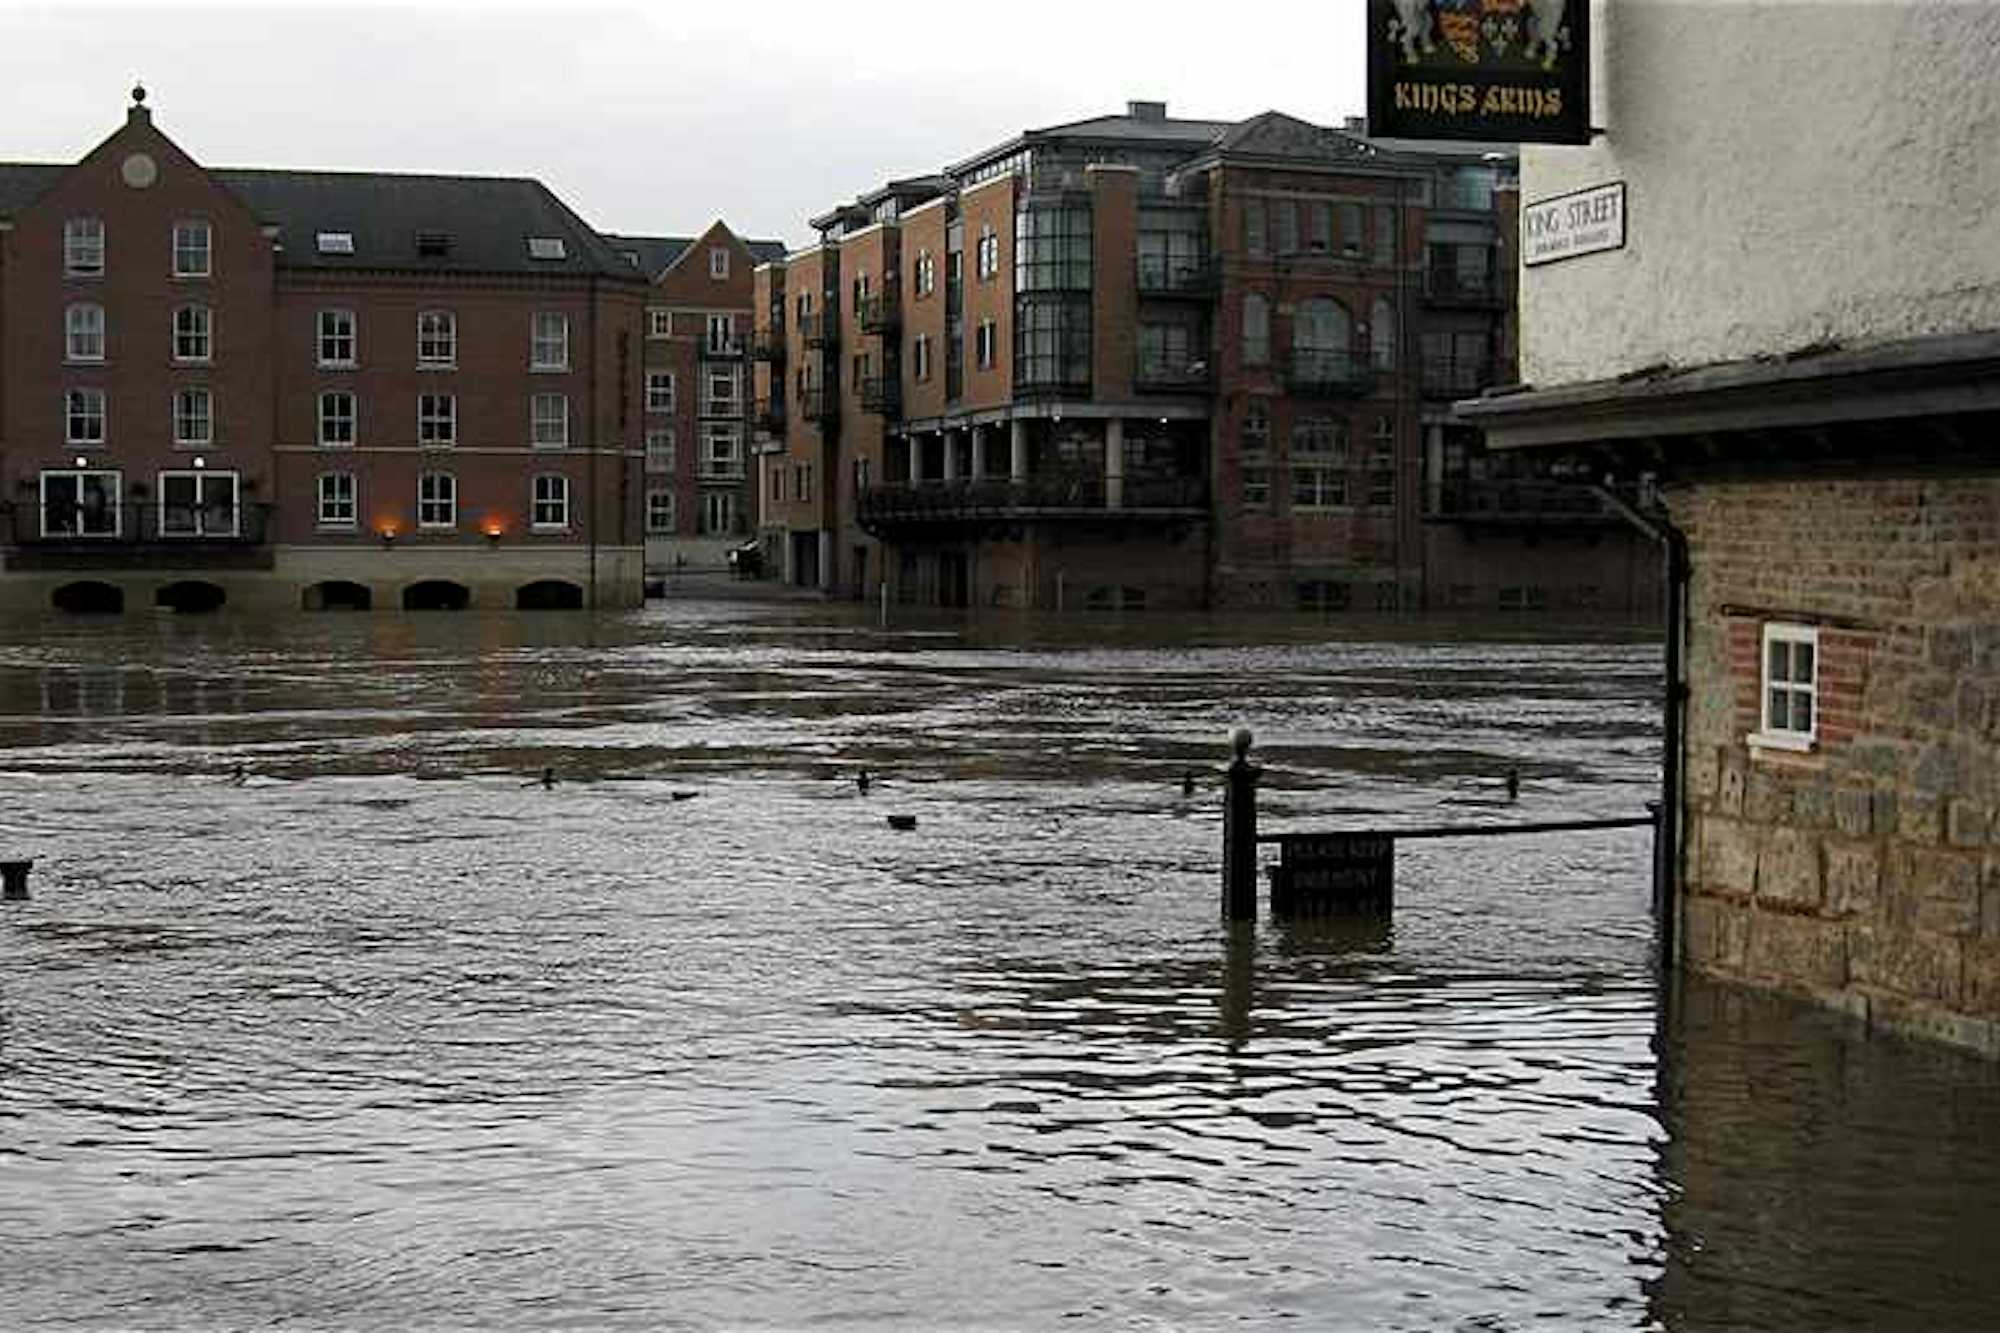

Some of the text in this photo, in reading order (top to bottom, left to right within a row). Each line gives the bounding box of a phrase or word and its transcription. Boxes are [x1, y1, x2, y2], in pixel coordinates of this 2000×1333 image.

[1394, 82, 1563, 119] KINGS ARMS
[1566, 192, 1619, 230] STREET
